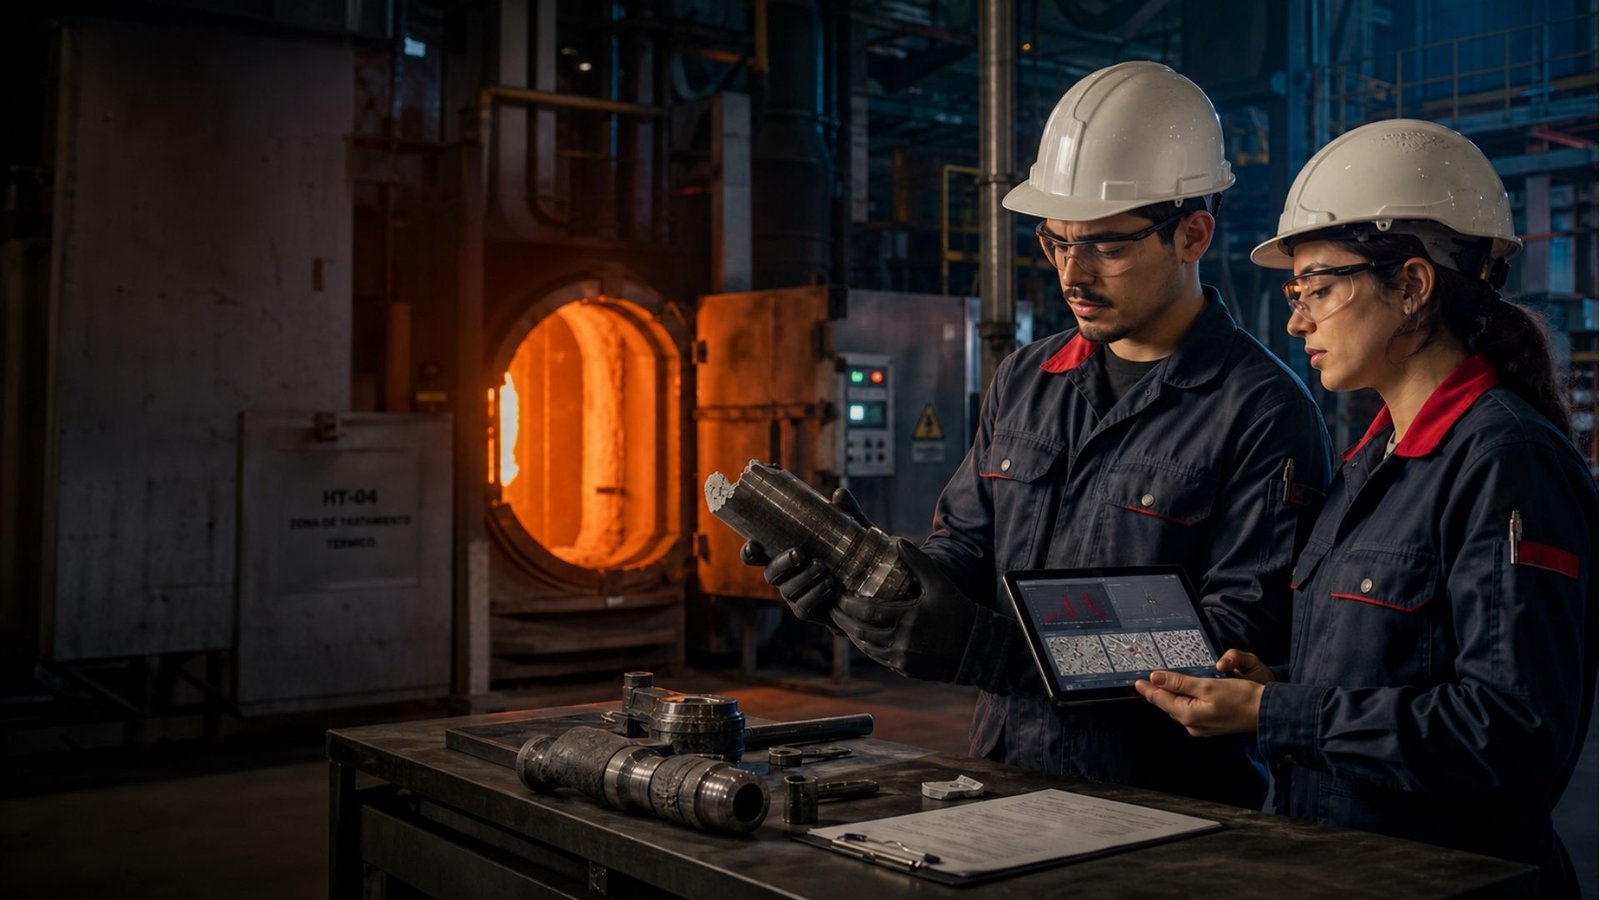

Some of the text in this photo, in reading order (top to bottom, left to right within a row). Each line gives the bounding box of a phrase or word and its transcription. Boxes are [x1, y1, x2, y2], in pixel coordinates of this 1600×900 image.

[323, 489, 377, 506] HT-04
[290, 518, 319, 530] ZONA
[321, 517, 336, 529] DE
